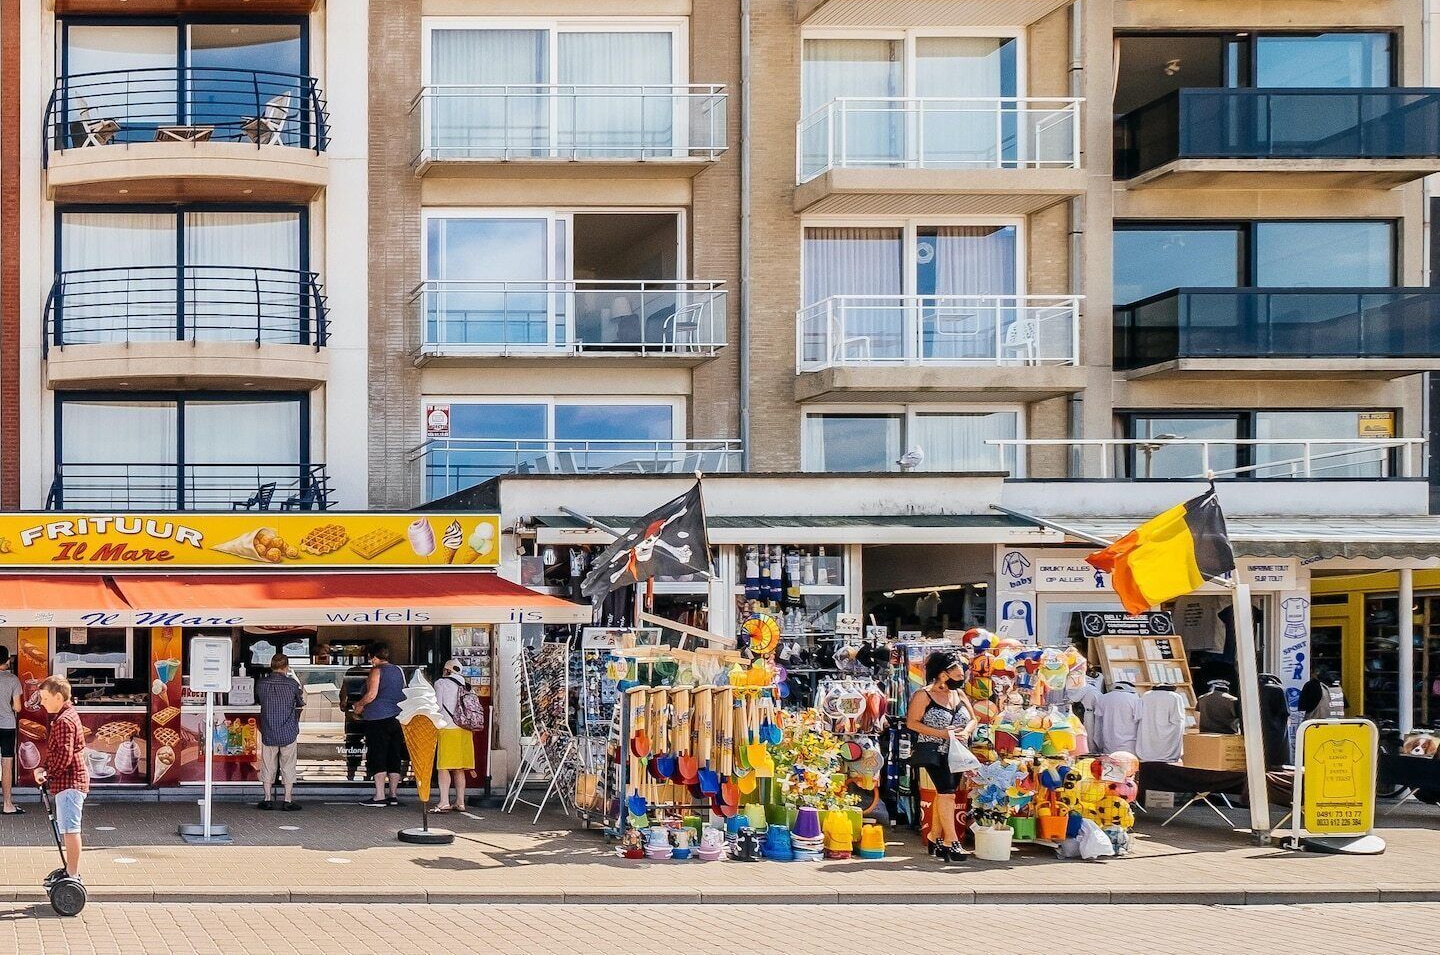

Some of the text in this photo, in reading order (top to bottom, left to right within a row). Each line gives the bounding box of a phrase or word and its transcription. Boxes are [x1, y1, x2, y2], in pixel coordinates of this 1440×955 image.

[19, 516, 204, 549] FRITUUR
[51, 541, 175, 562] Il Mare
[1009, 576, 1033, 589] baby
[80, 612, 119, 626] Il
[135, 612, 245, 626] Mare
[326, 608, 430, 623] wafels
[510, 608, 543, 624] ijs
[1282, 641, 1308, 655] SPORT
